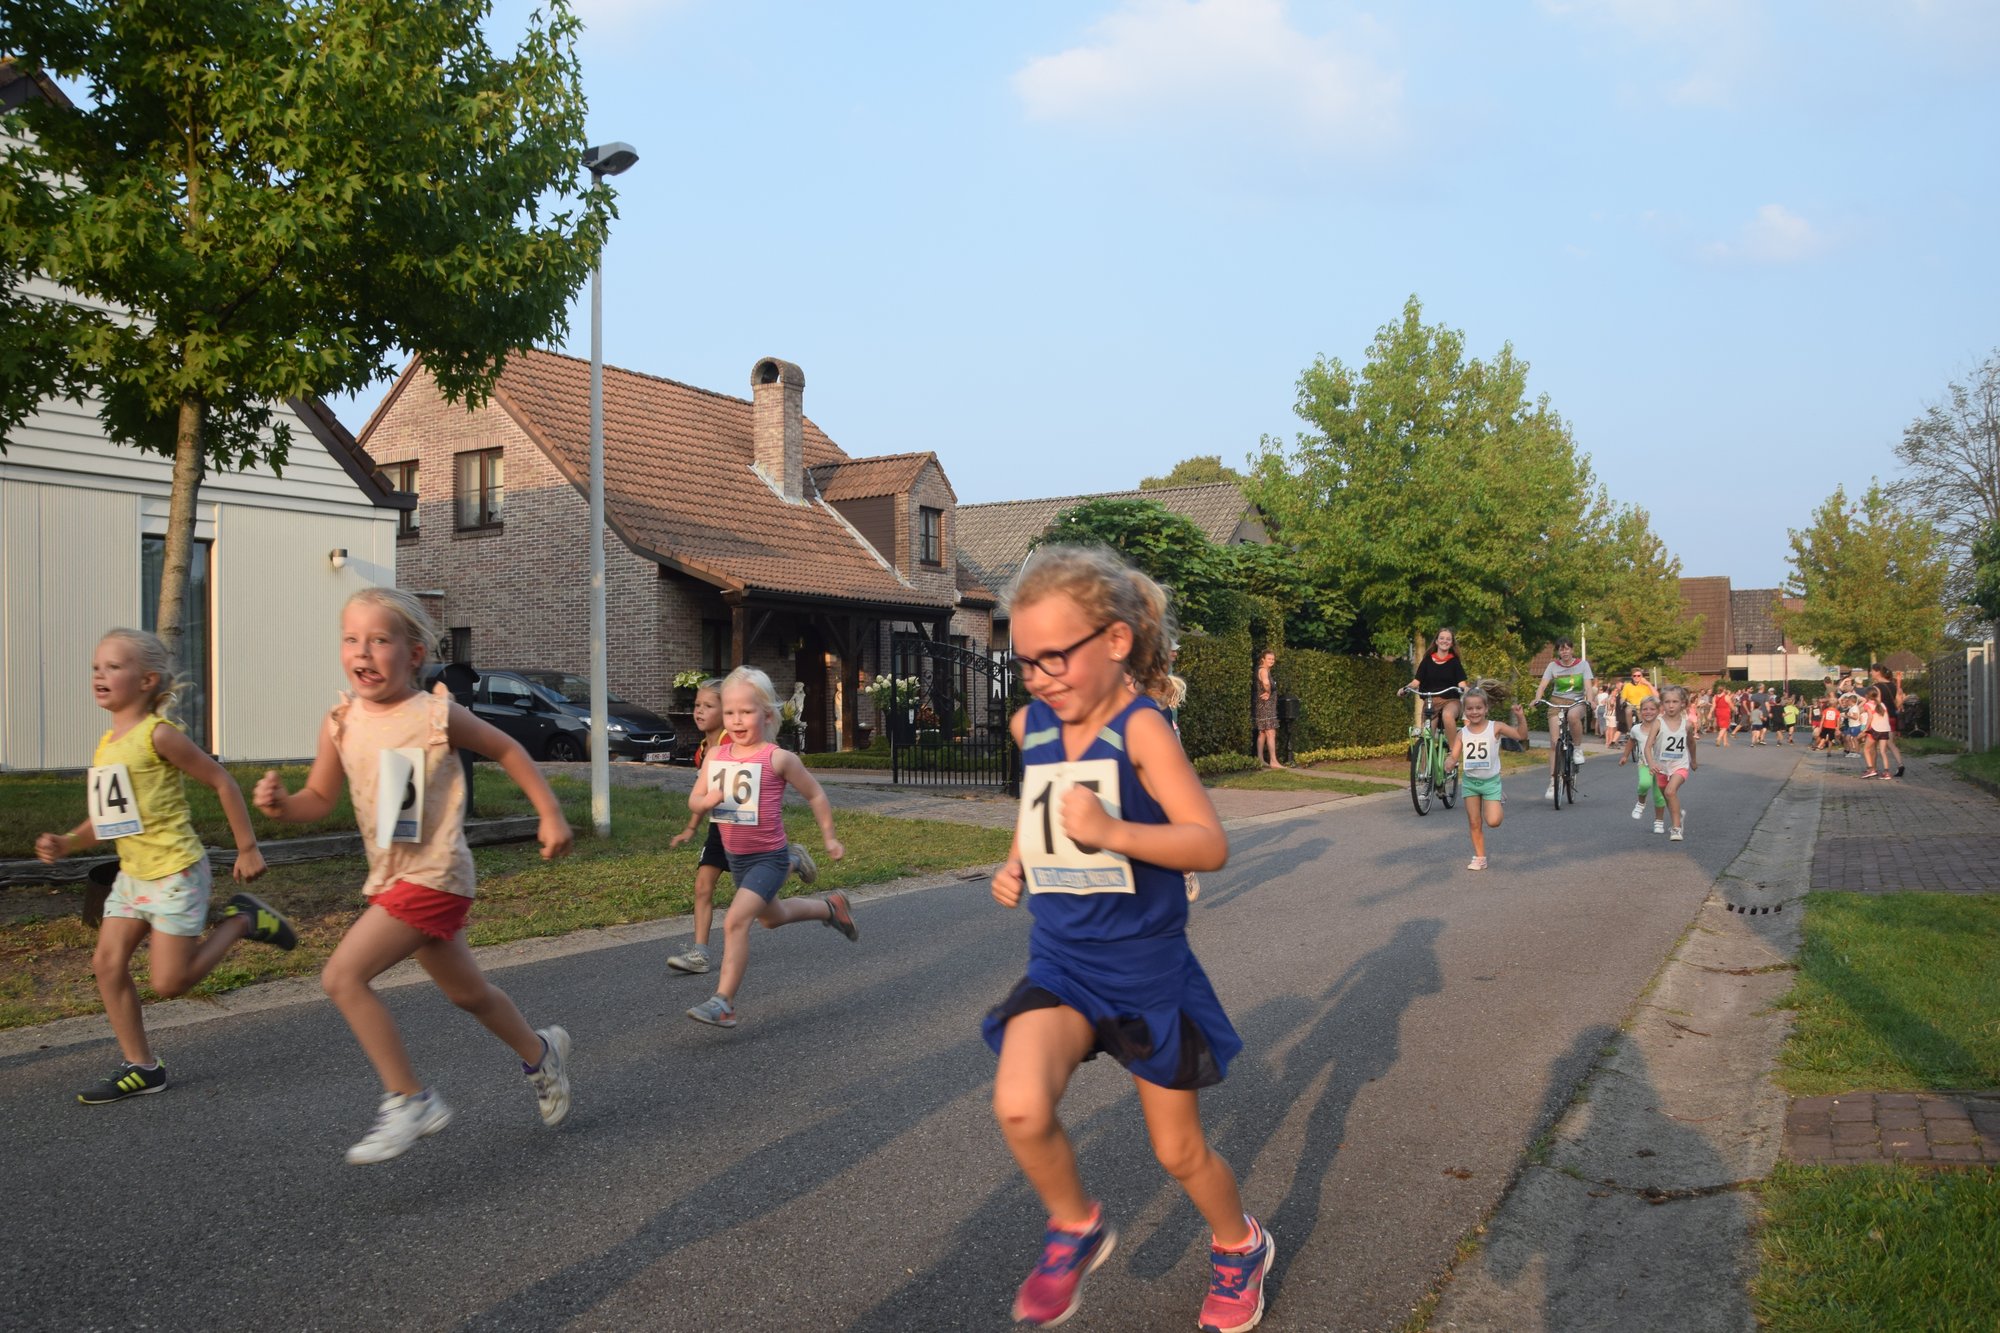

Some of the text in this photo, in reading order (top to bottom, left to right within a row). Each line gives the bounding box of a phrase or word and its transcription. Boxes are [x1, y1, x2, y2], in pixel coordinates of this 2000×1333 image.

[1466, 741, 1488, 760] 25
[1665, 736, 1685, 752] 24
[94, 773, 128, 816] 14
[713, 768, 752, 805] 16
